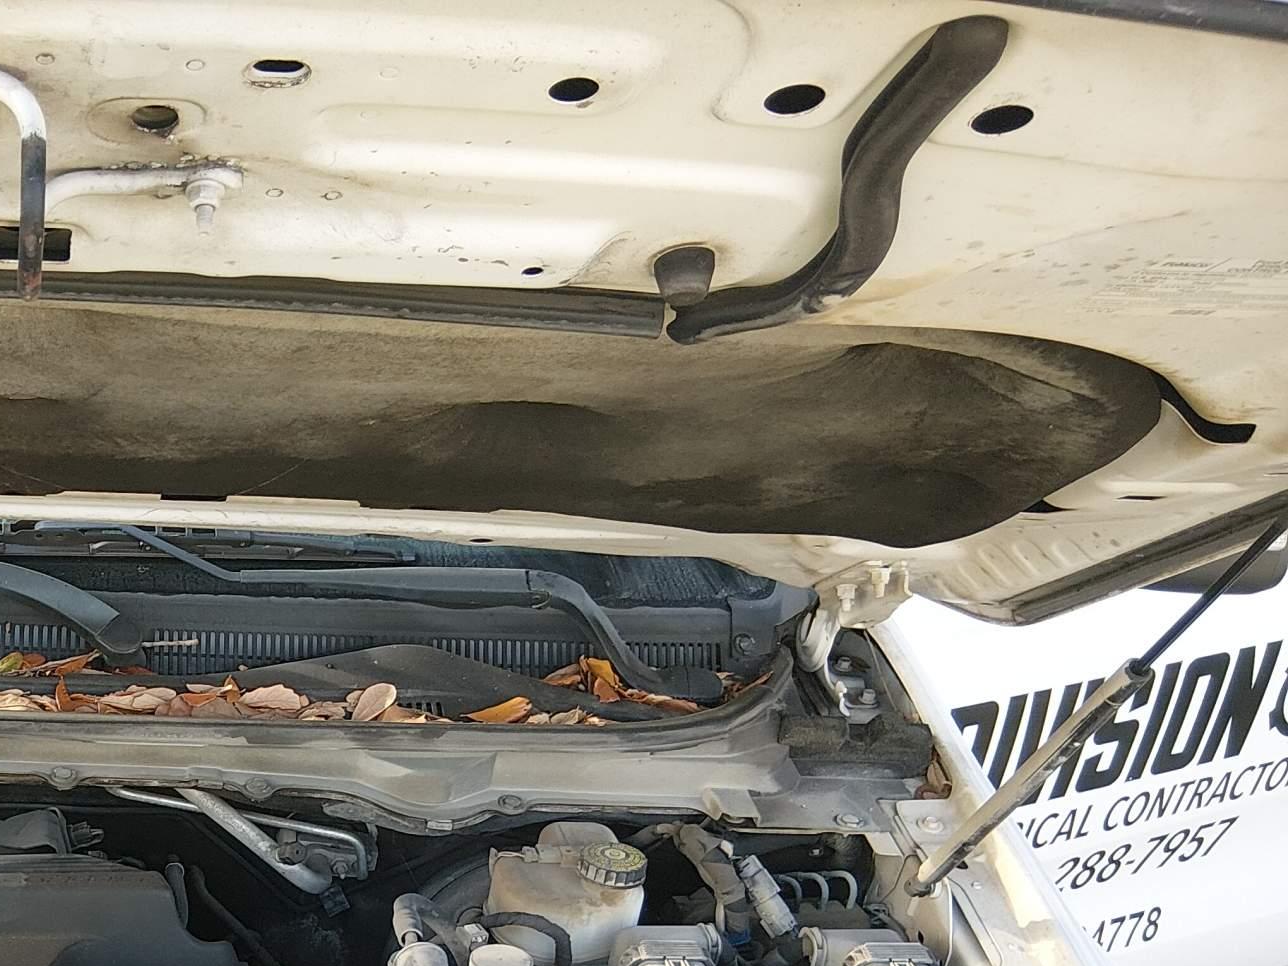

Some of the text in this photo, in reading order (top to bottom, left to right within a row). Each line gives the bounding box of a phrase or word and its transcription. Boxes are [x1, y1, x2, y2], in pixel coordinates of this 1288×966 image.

[1017, 757, 1288, 849] ICAL CONTRACTO
[1055, 815, 1239, 892] 288-7957
